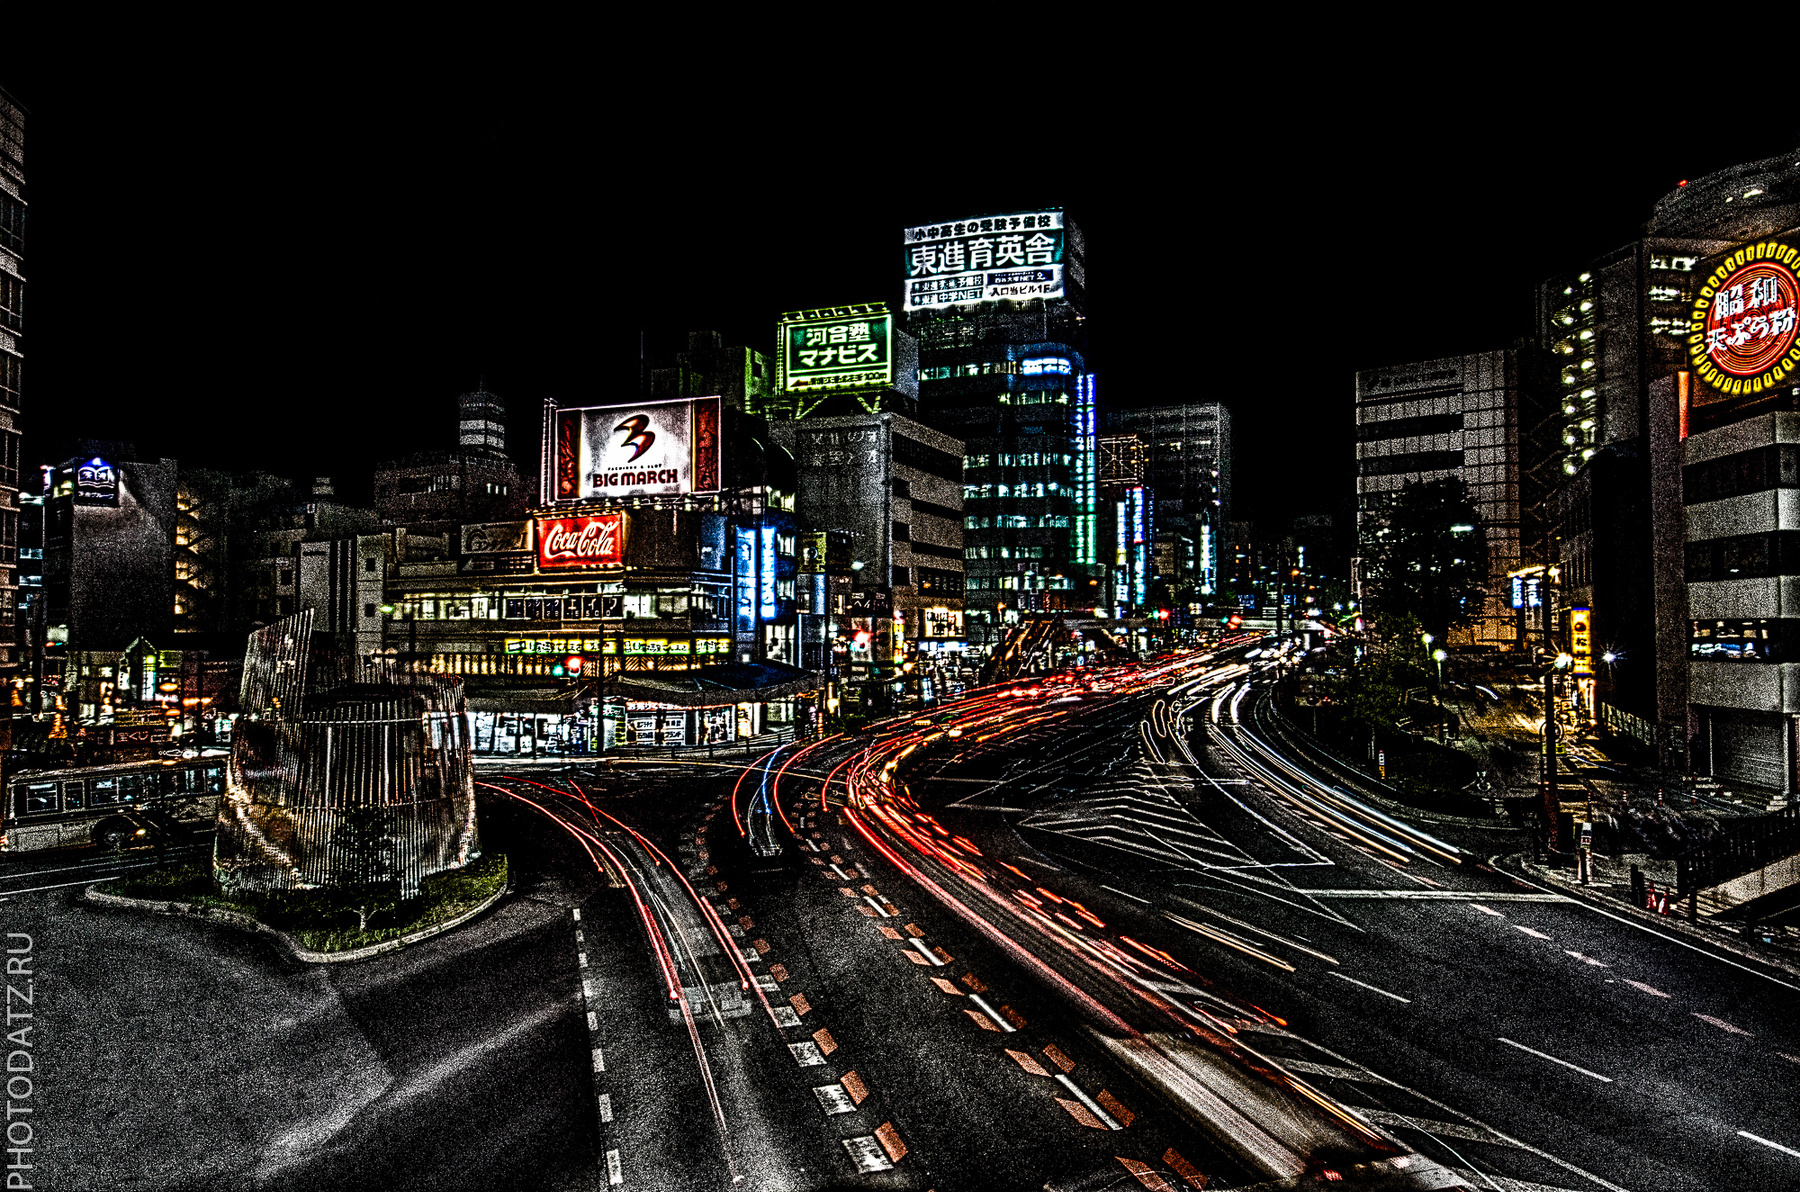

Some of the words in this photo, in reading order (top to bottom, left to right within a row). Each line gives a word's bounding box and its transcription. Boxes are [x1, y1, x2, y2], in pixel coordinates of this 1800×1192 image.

[914, 215, 1051, 241] 小中高生の受験予備校
[910, 233, 1055, 277] 東進育英舎
[990, 284, 1051, 297] 入口当ビル1F
[1714, 276, 1779, 321] 昭和
[806, 322, 871, 347] 河合塾
[1705, 307, 1797, 354] 天ぷら粉
[798, 343, 879, 367] マナビス
[592, 473, 619, 488] BIG
[620, 468, 678, 486] MARCH
[544, 521, 620, 559] Coca-Cola
